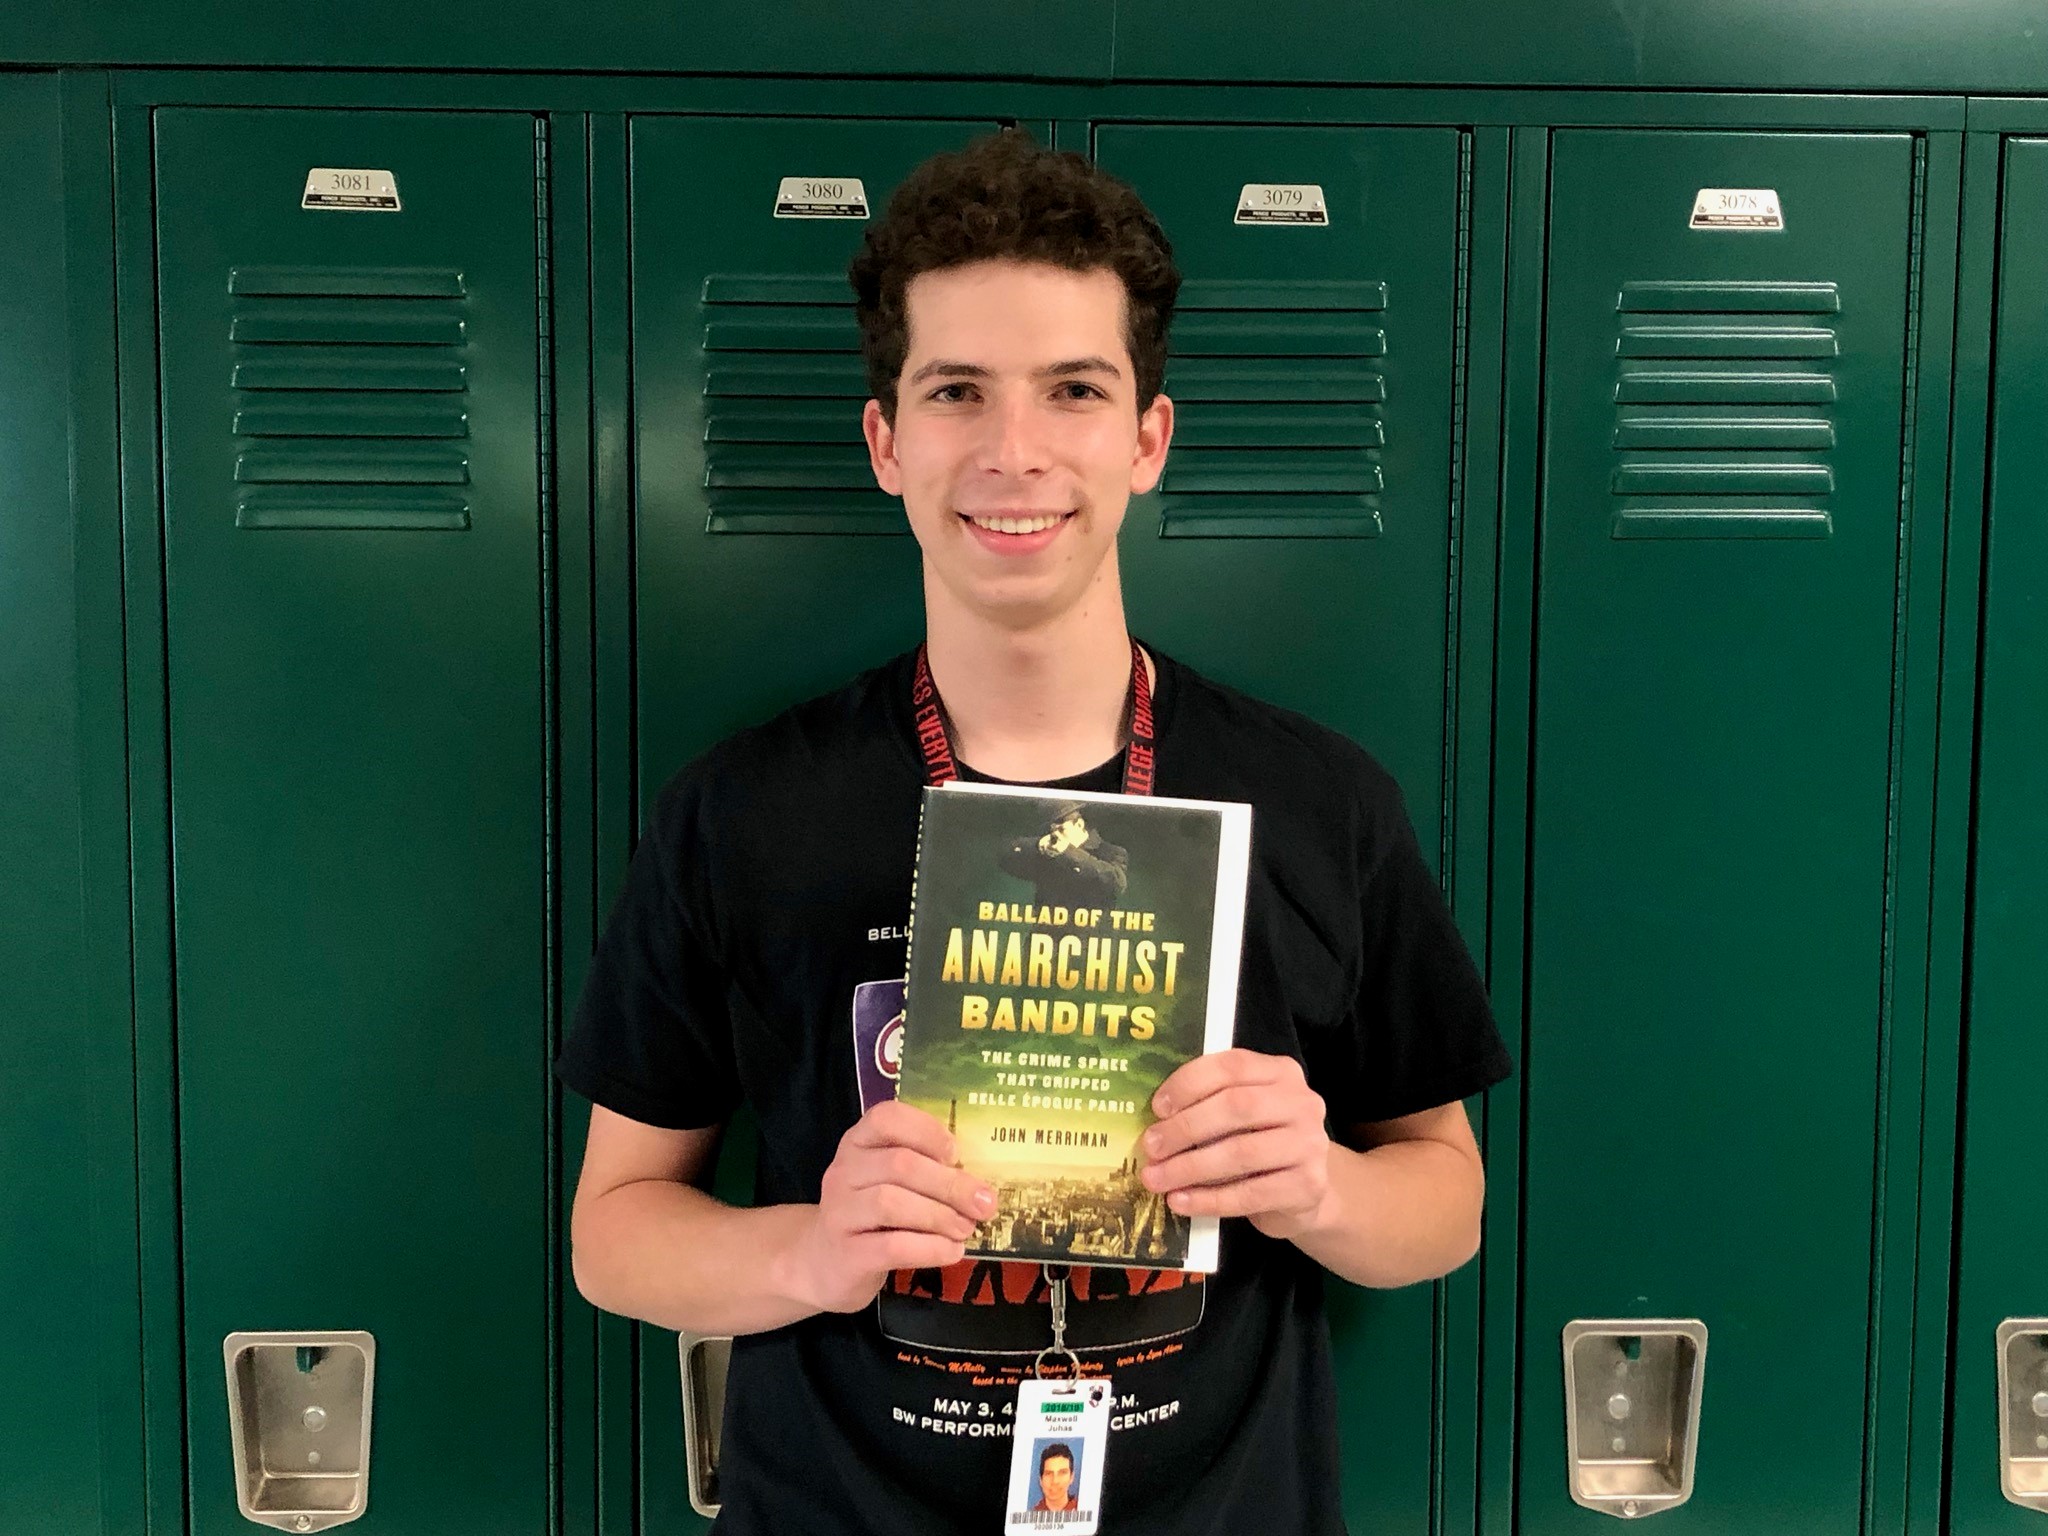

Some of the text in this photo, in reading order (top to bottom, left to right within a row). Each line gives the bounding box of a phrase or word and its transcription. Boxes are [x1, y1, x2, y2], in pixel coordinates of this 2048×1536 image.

[331, 174, 371, 190] 3081
[802, 183, 843, 199] 3080
[1263, 189, 1303, 205] 3079
[1719, 194, 1758, 210] 3078
[979, 901, 1155, 932] BALLAD OF THE
[941, 927, 1185, 996] ANARCHIST
[960, 995, 1156, 1041] BANDITS
[981, 1050, 1129, 1072] THE CRIME SPREE
[996, 1072, 1110, 1091] THAT GRIPPED
[968, 1091, 1135, 1114] BELLE ÉPOQUE PARIS
[991, 1126, 1108, 1148] JOHN MERRIMAN
[893, 1407, 916, 1426] BW
[1110, 1400, 1180, 1431] CENTER
[933, 1398, 972, 1416] MAY
[977, 1402, 994, 1418] 3,
